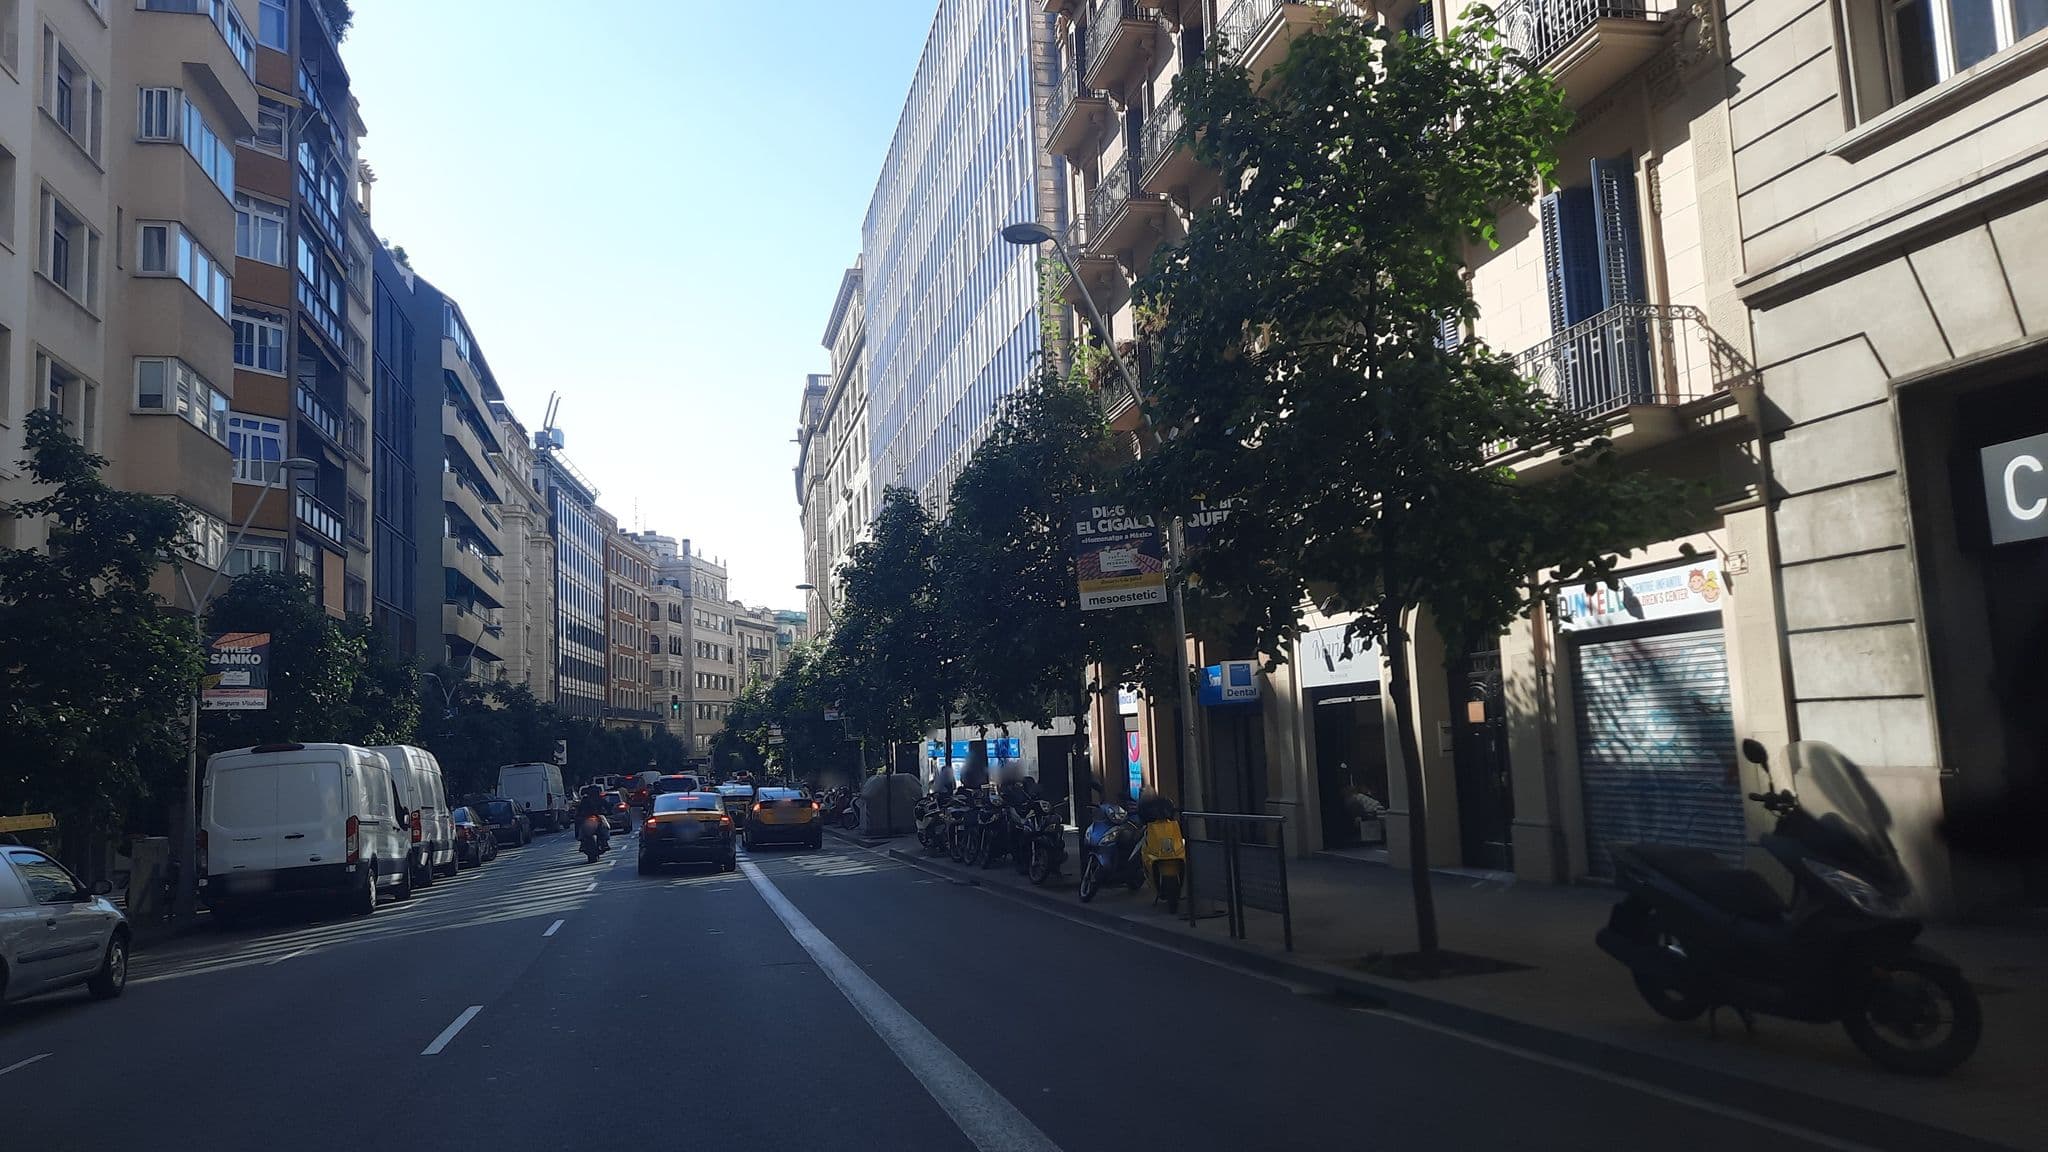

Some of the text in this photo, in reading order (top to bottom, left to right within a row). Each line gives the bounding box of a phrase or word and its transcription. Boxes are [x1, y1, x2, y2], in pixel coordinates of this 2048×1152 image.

[2003, 454, 2048, 520] C
[1076, 515, 1155, 535] EL CIGALA
[1089, 590, 1158, 606] mesoestetic
[1665, 588, 1689, 602] CENTER
[210, 653, 262, 665] SANKO
[1226, 688, 1257, 697] Dental
